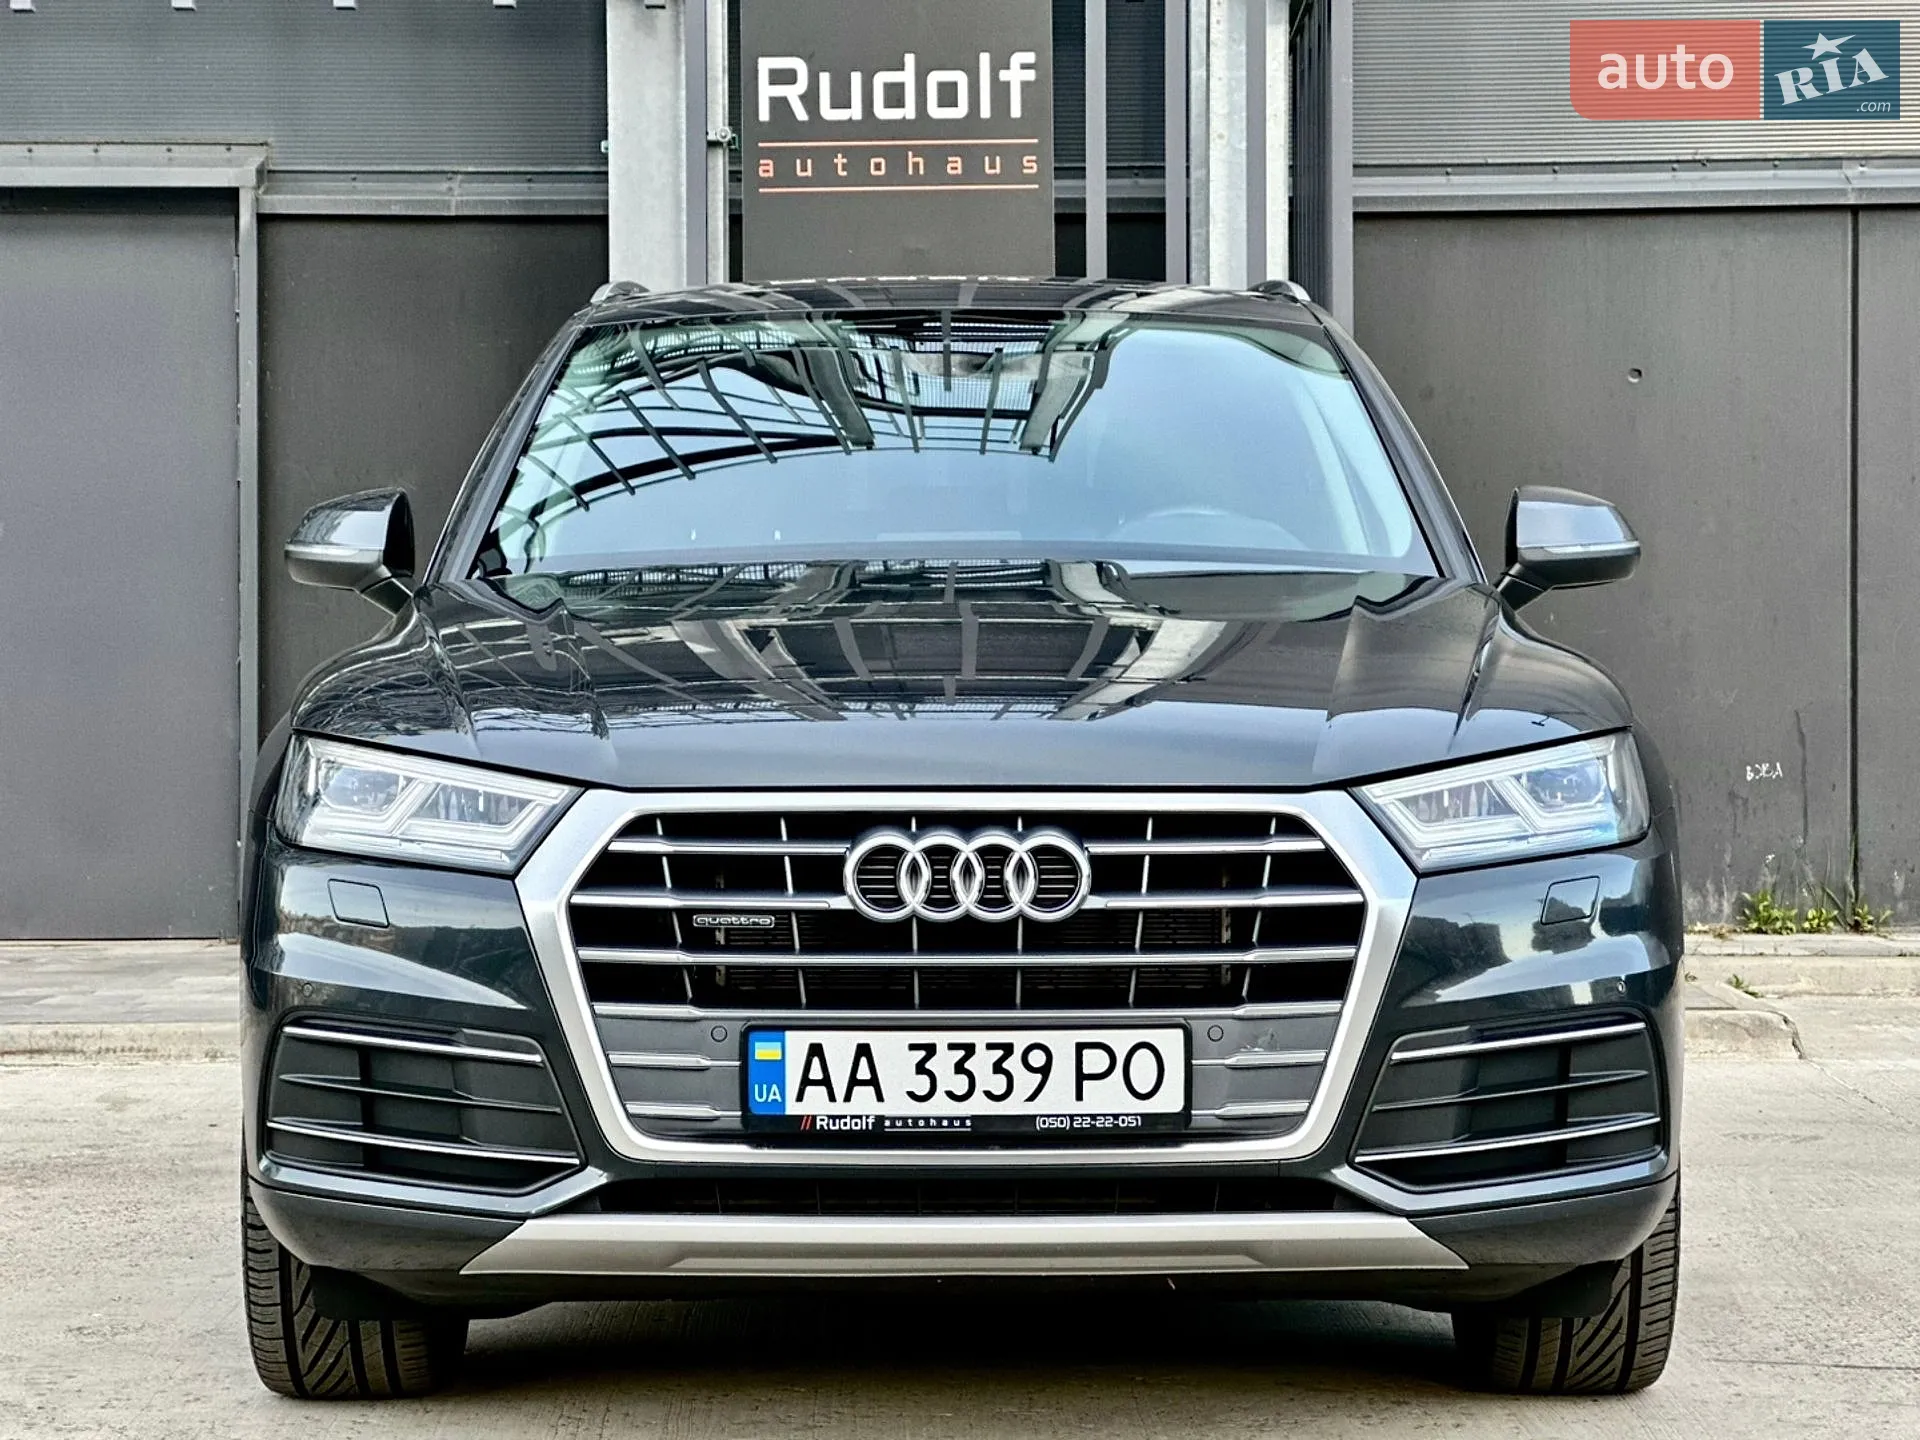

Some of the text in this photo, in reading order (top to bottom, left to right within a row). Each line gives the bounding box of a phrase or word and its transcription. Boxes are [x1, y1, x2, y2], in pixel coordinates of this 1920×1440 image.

[757, 51, 1037, 122] Rudolf
[758, 151, 1039, 178] autohaus
[695, 915, 771, 927] quattro
[795, 1041, 1166, 1103] AA 3339 PO
[754, 1084, 782, 1104] UA
[816, 1115, 971, 1130] Rudolf autohaus
[1036, 1115, 1142, 1131] (050) 22-22-051
